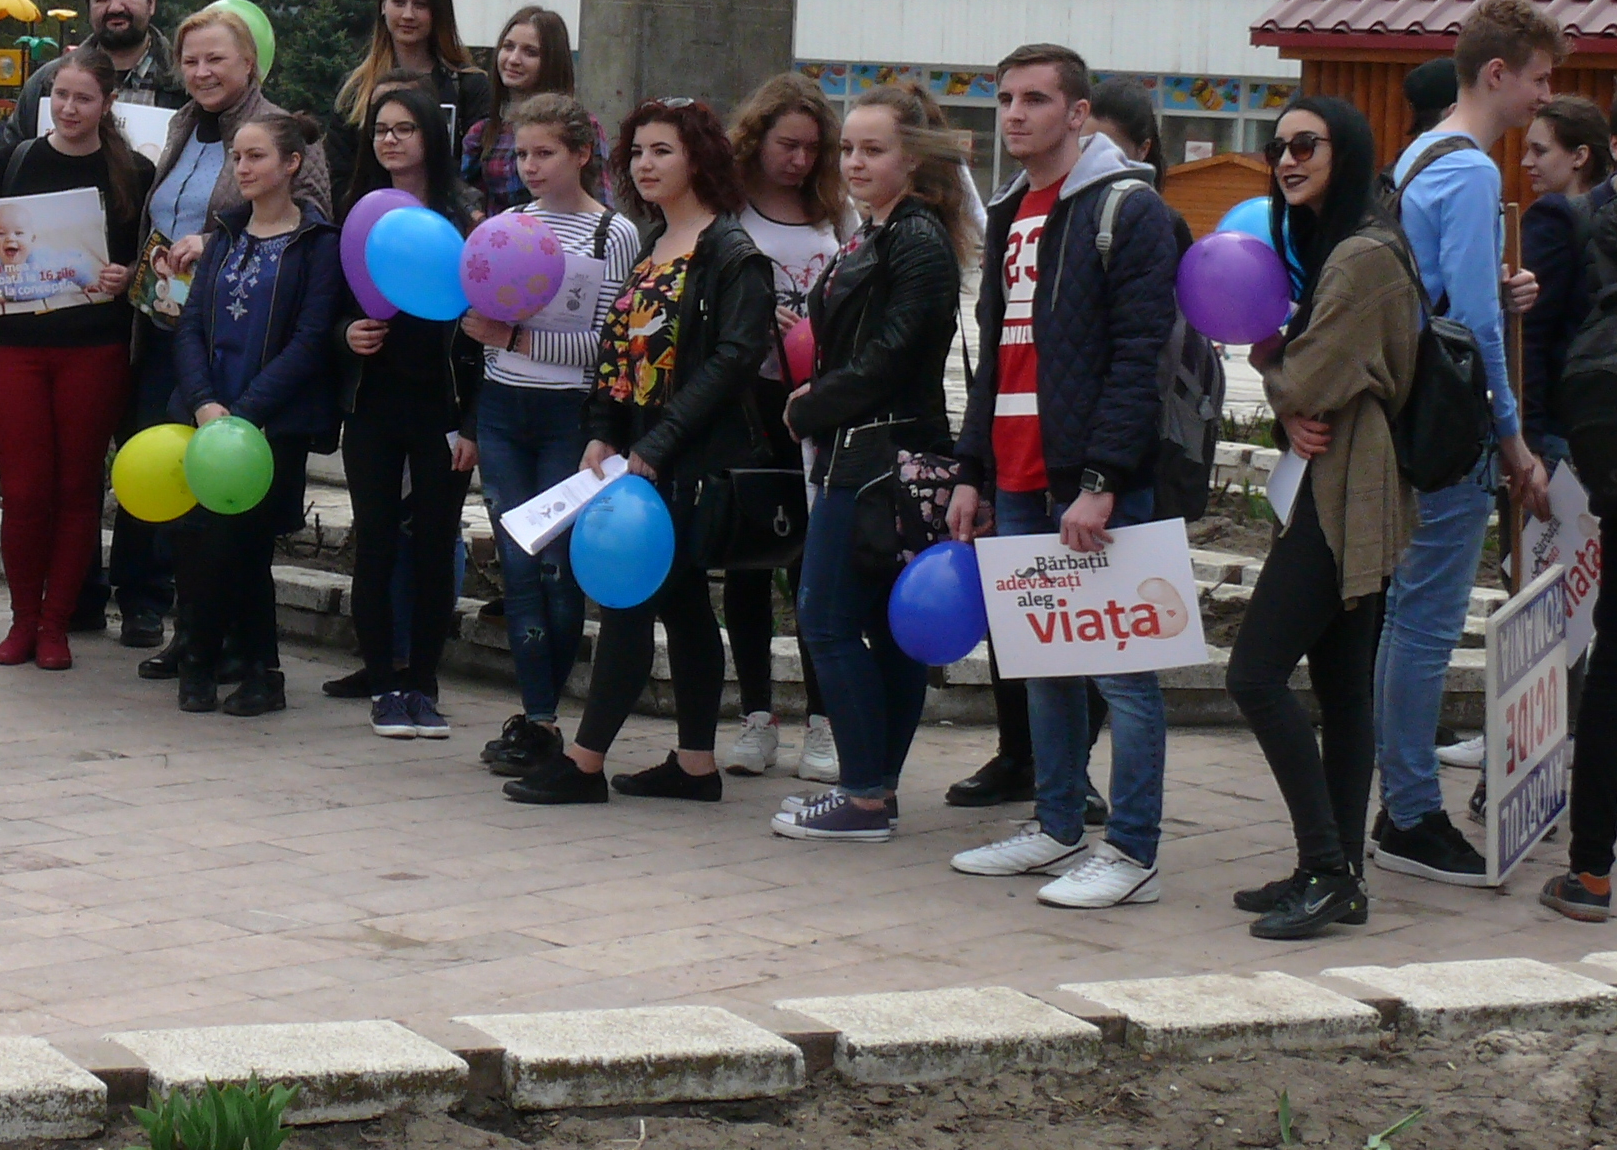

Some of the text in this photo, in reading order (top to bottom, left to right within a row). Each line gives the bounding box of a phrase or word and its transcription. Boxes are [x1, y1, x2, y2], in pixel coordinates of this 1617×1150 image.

[39, 270, 53, 281] 16
[1034, 551, 1110, 574] Bărbații
[1017, 592, 1055, 610] aleg
[1026, 598, 1161, 651] viața
[1506, 665, 1558, 778] UCIDE
[1502, 746, 1565, 861] AVORTUL
